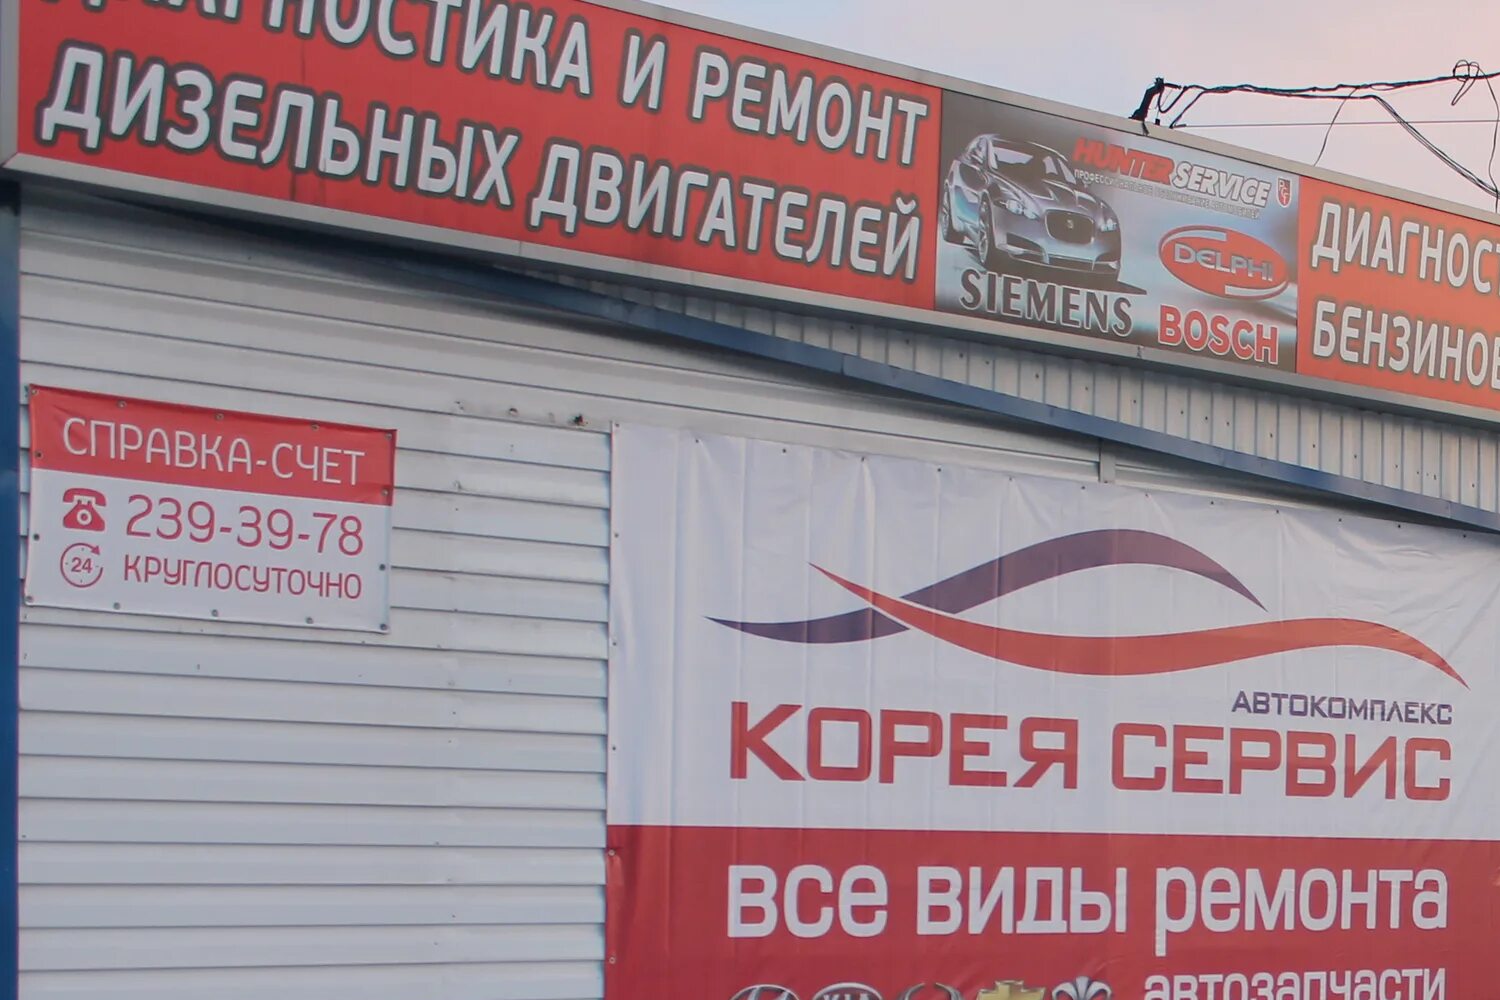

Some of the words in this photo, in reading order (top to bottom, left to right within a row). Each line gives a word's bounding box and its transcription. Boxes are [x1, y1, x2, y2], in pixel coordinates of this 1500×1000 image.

[91, 0, 590, 95] ОСТИКА
[622, 35, 666, 109] И
[692, 52, 927, 164] РЕМОНТ
[41, 47, 518, 206] ДИЗЕЛЬНЫХ
[530, 144, 920, 280] ДВИГАТЕЛЕЙ
[1073, 137, 1175, 186] HUNTER
[1172, 161, 1272, 208] SERVICE
[1174, 243, 1274, 282] DELPHI
[959, 268, 1133, 337] SIEMENS
[1158, 304, 1279, 365] BOSCH
[63, 417, 365, 486] СПРАВКА-СЧЕТ
[126, 494, 364, 556] 239-39-78
[71, 556, 93, 574] 24
[124, 554, 362, 599] КРУГЛОСУТОЧНО
[1231, 690, 1453, 726] АВТОКОМПЛЕКС
[729, 702, 1079, 790] КОРЕЯ
[1111, 722, 1451, 800] СЕРВИС
[916, 865, 1126, 936] виды
[1156, 866, 1449, 957] ремонта
